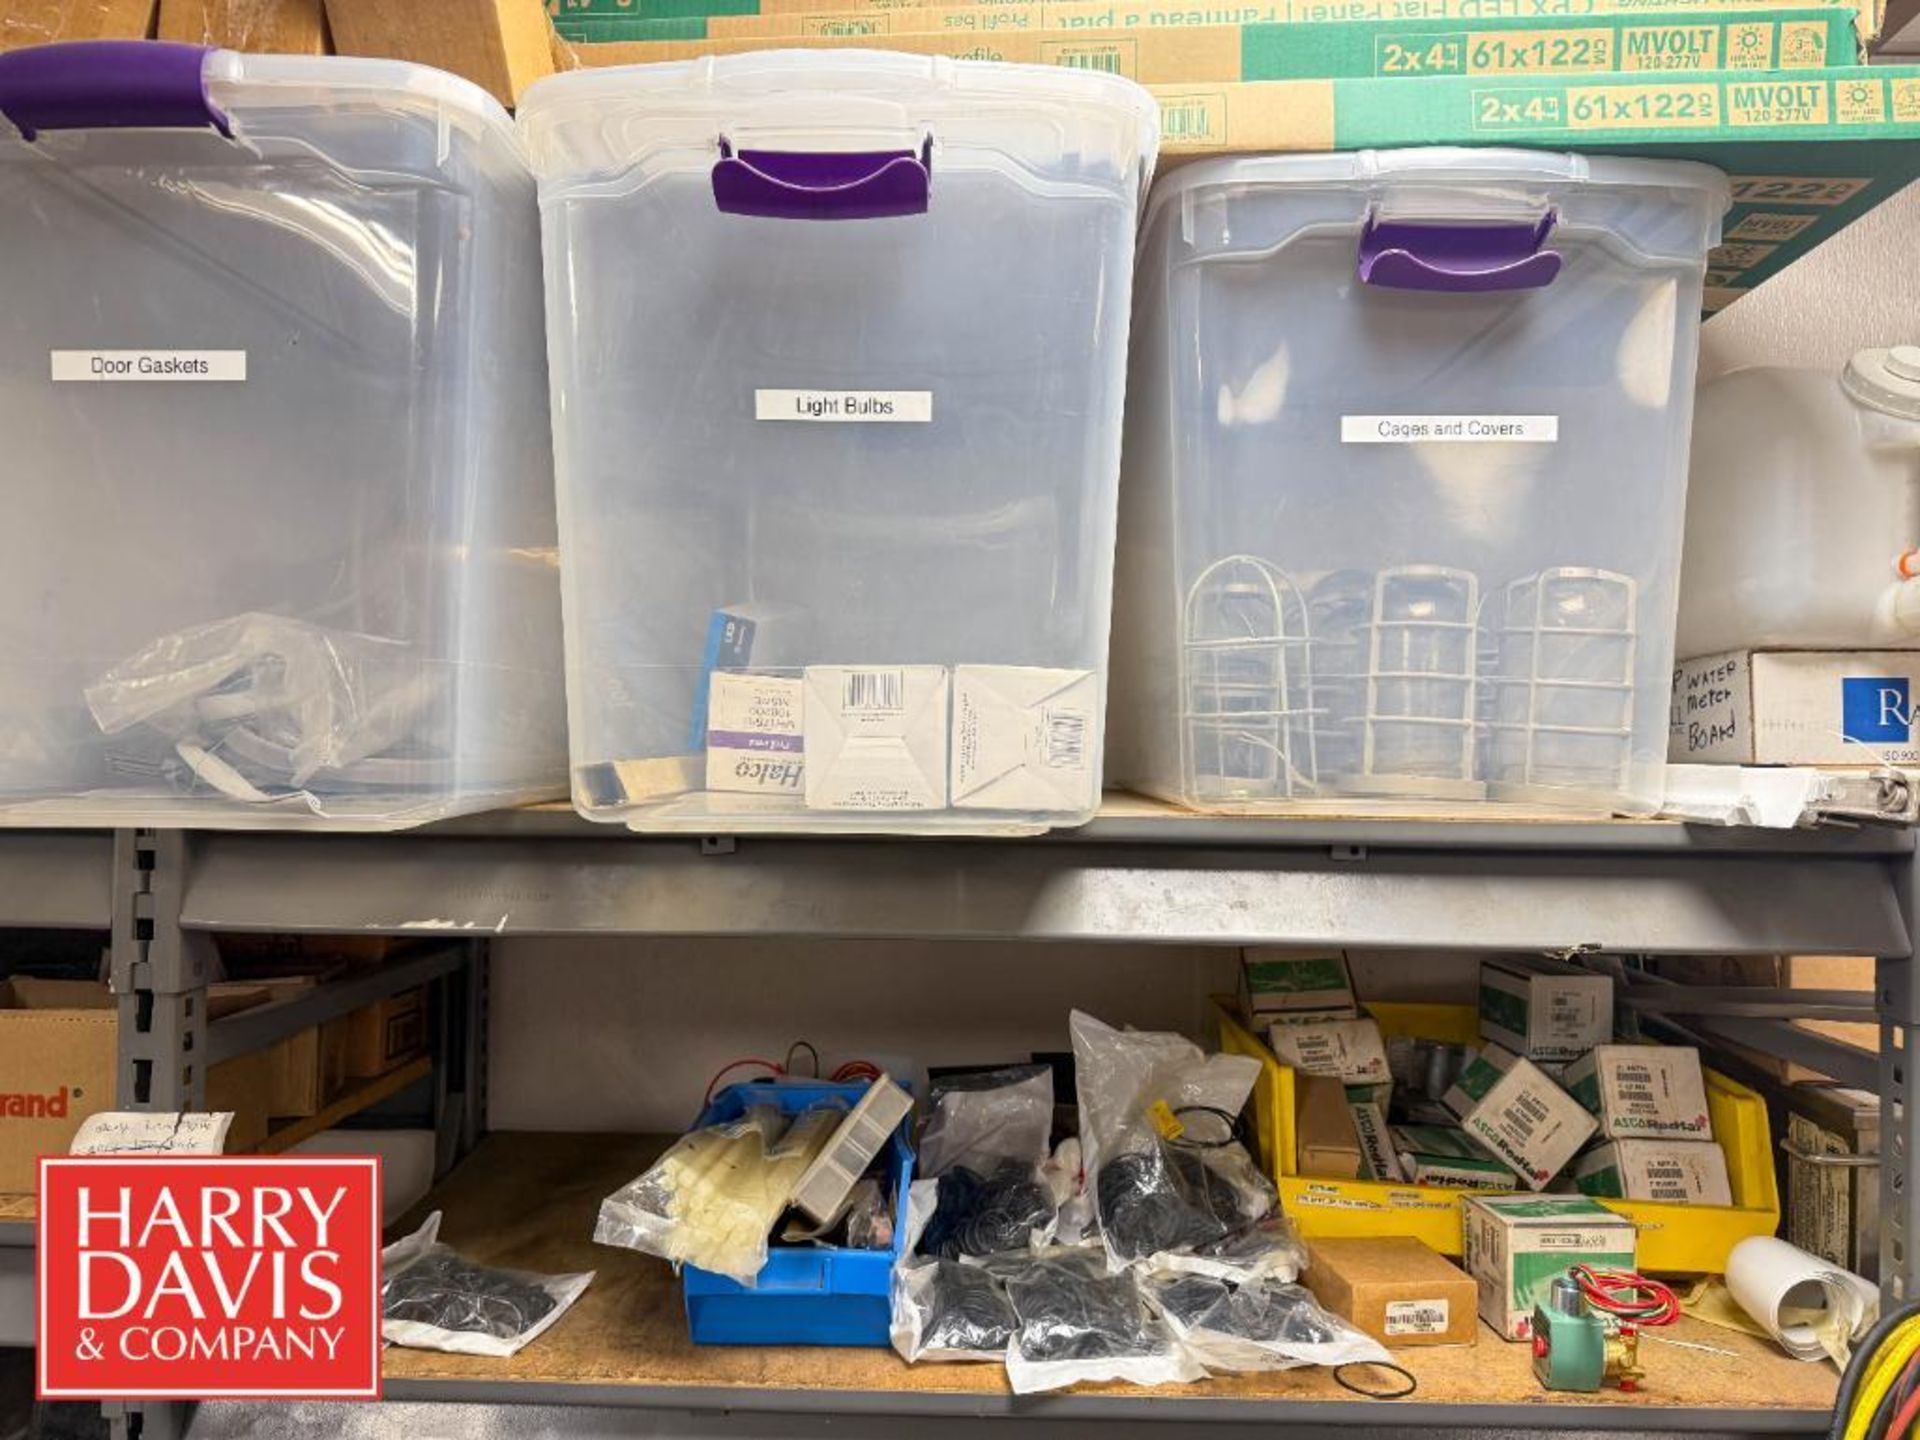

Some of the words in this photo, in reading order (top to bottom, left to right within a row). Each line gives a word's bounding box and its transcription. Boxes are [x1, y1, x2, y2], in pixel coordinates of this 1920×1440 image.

[944, 14, 975, 30] bas
[982, 13, 1029, 31] Profil
[1627, 30, 1713, 55] MVOLT
[1382, 42, 1444, 72] 2x4
[1472, 39, 1590, 69] 61x122
[1480, 96, 1544, 123] 2x4
[1573, 93, 1695, 120] 61x122
[1734, 86, 1821, 108] MVOLT
[91, 356, 133, 374] Door
[138, 356, 209, 374] Gaskets
[796, 396, 839, 416] Light
[845, 396, 894, 415] Bulbs
[1434, 421, 1462, 436] and
[1468, 420, 1524, 436] Covers
[1687, 660, 1737, 690] WATER
[735, 760, 804, 787] Halco
